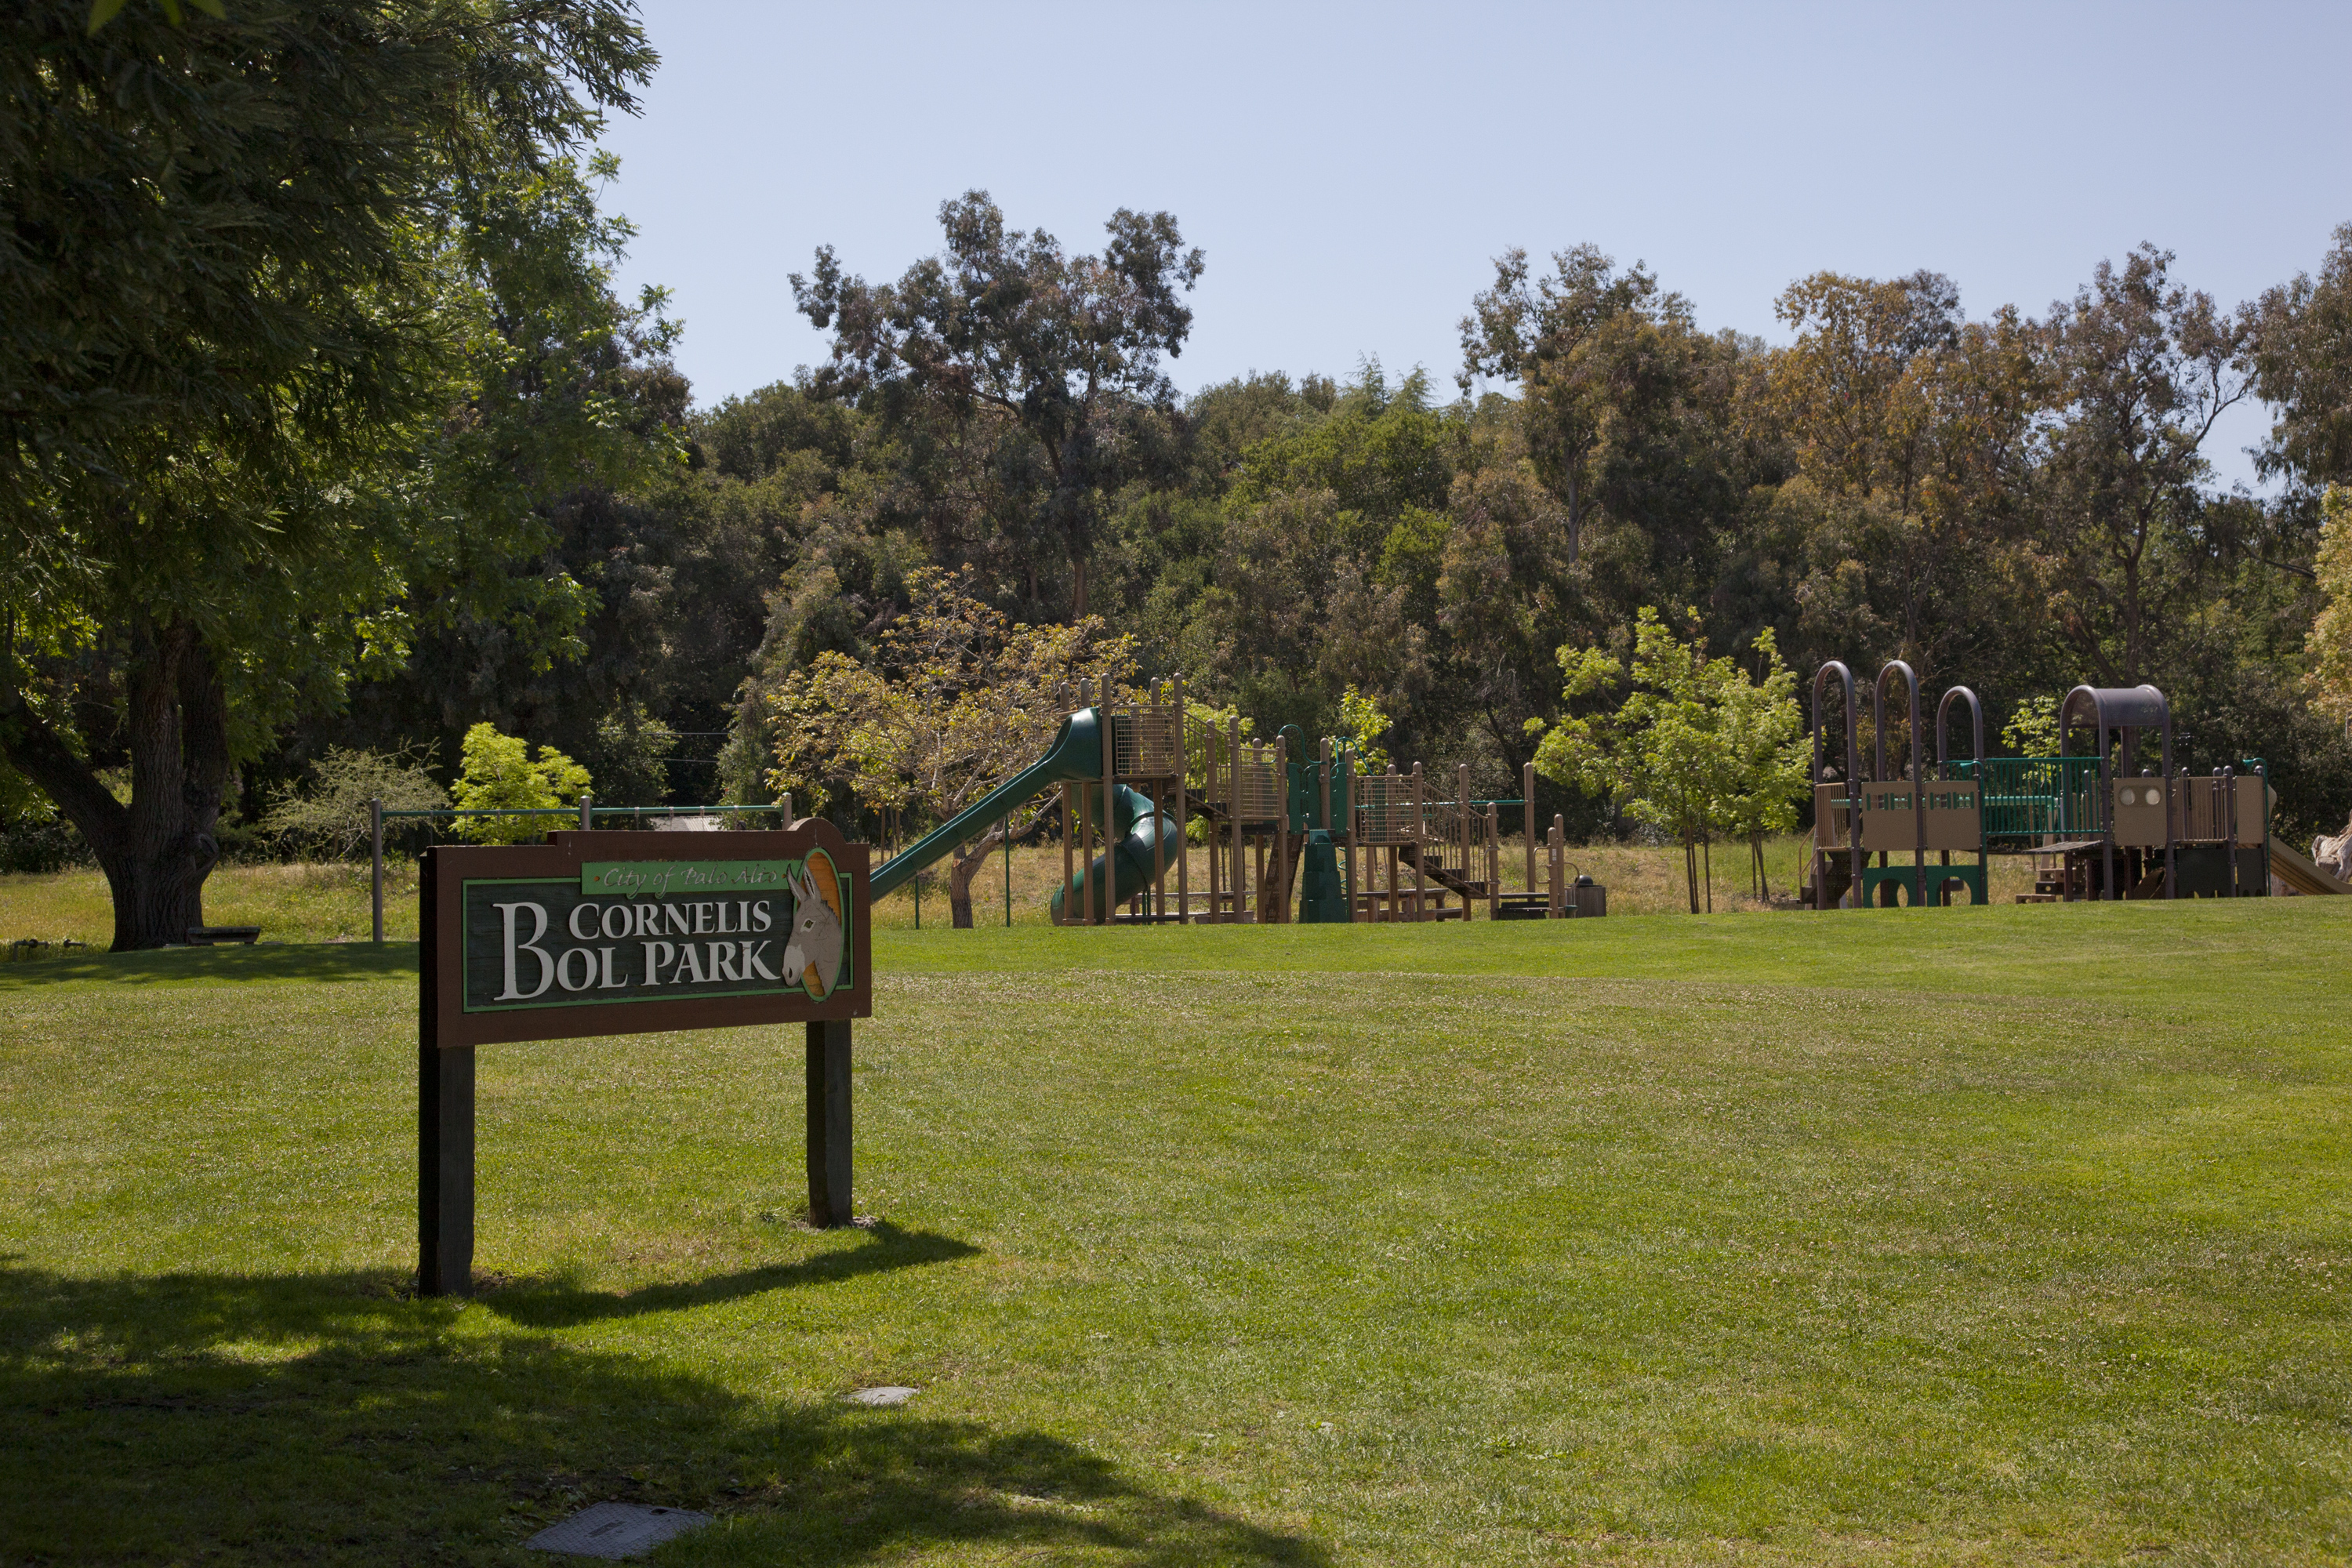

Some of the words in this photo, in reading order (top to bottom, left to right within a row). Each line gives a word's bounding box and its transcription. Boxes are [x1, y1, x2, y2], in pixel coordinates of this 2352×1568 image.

[604, 866, 648, 899] City
[653, 864, 678, 899] of
[681, 864, 728, 886] Palo
[731, 863, 777, 884] Alto
[568, 900, 772, 940] CORNELIS
[492, 902, 628, 1001] BOL
[640, 940, 782, 986] PARK
